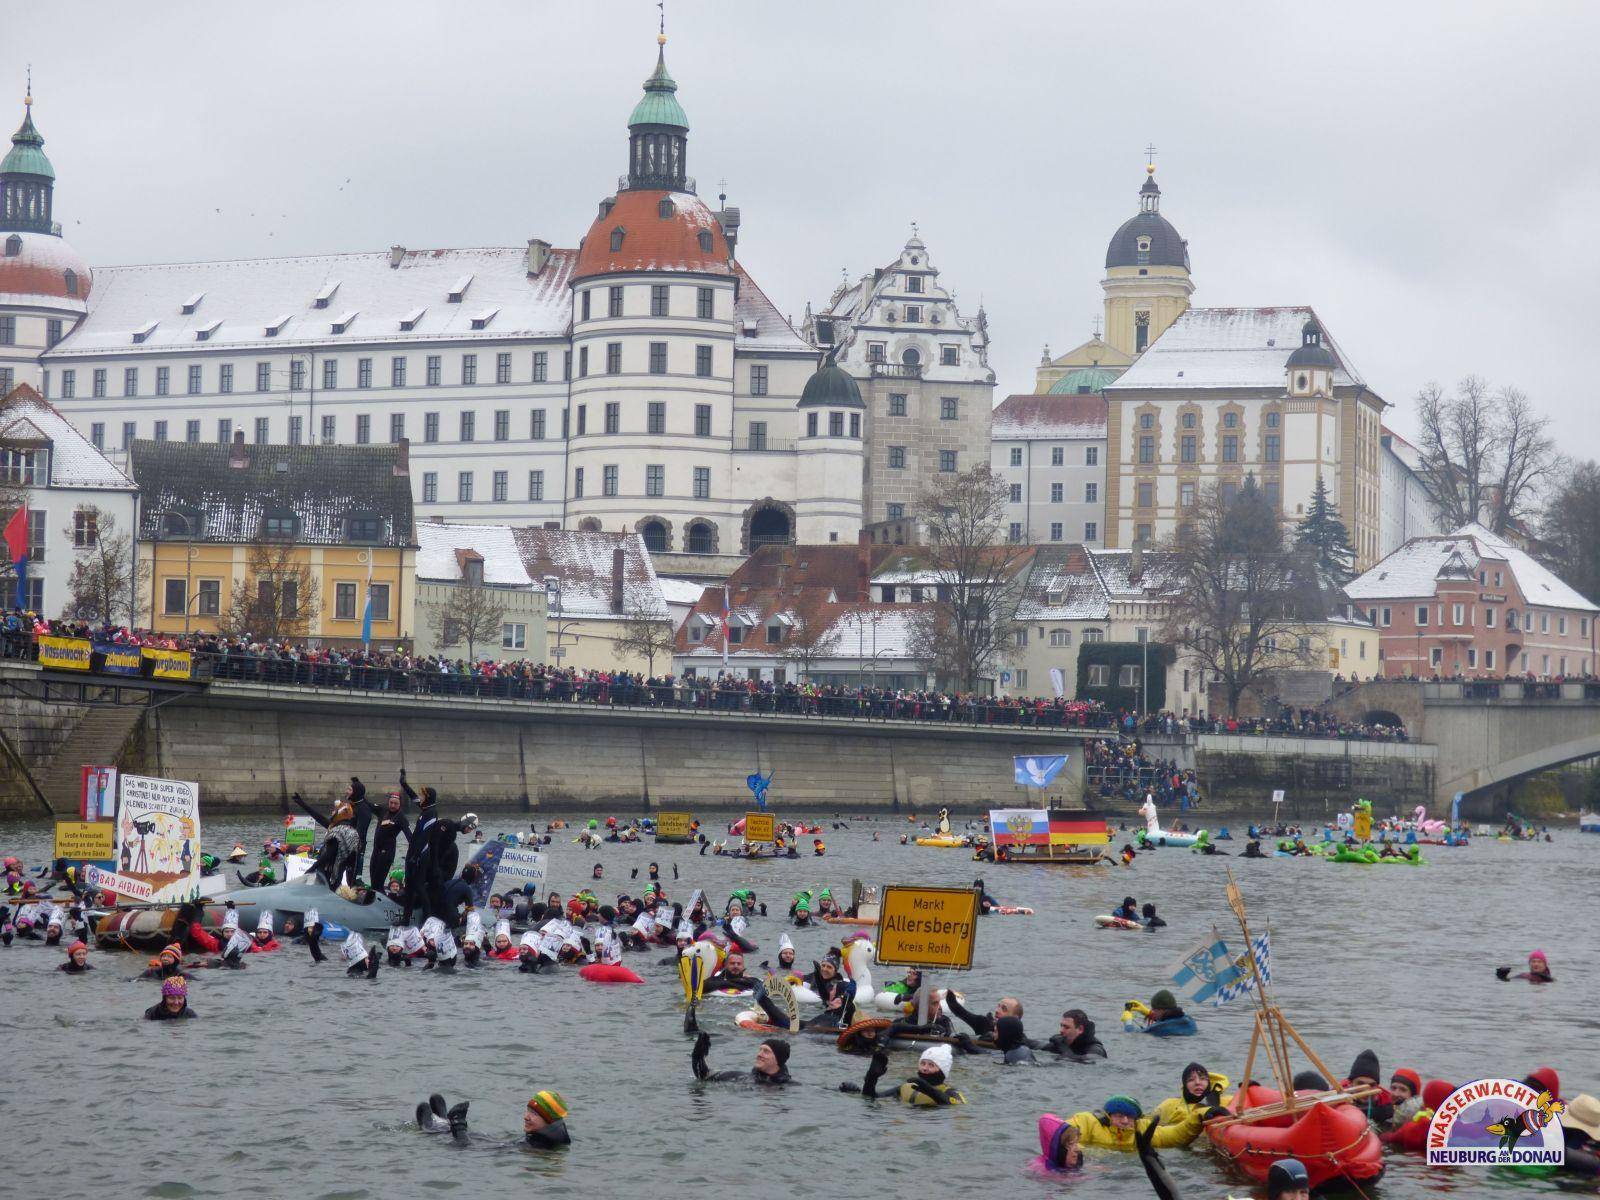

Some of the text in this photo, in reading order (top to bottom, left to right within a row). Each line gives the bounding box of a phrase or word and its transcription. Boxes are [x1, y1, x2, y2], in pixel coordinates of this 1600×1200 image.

[126, 778, 135, 788] DAS
[138, 781, 149, 790] WIRD
[151, 783, 159, 791] EIN
[160, 784, 174, 793] SUPER
[99, 873, 151, 898] BAD AIBLING
[913, 897, 945, 910] Markt
[884, 914, 970, 939] Allersberg
[897, 940, 951, 955] Kreis Roth
